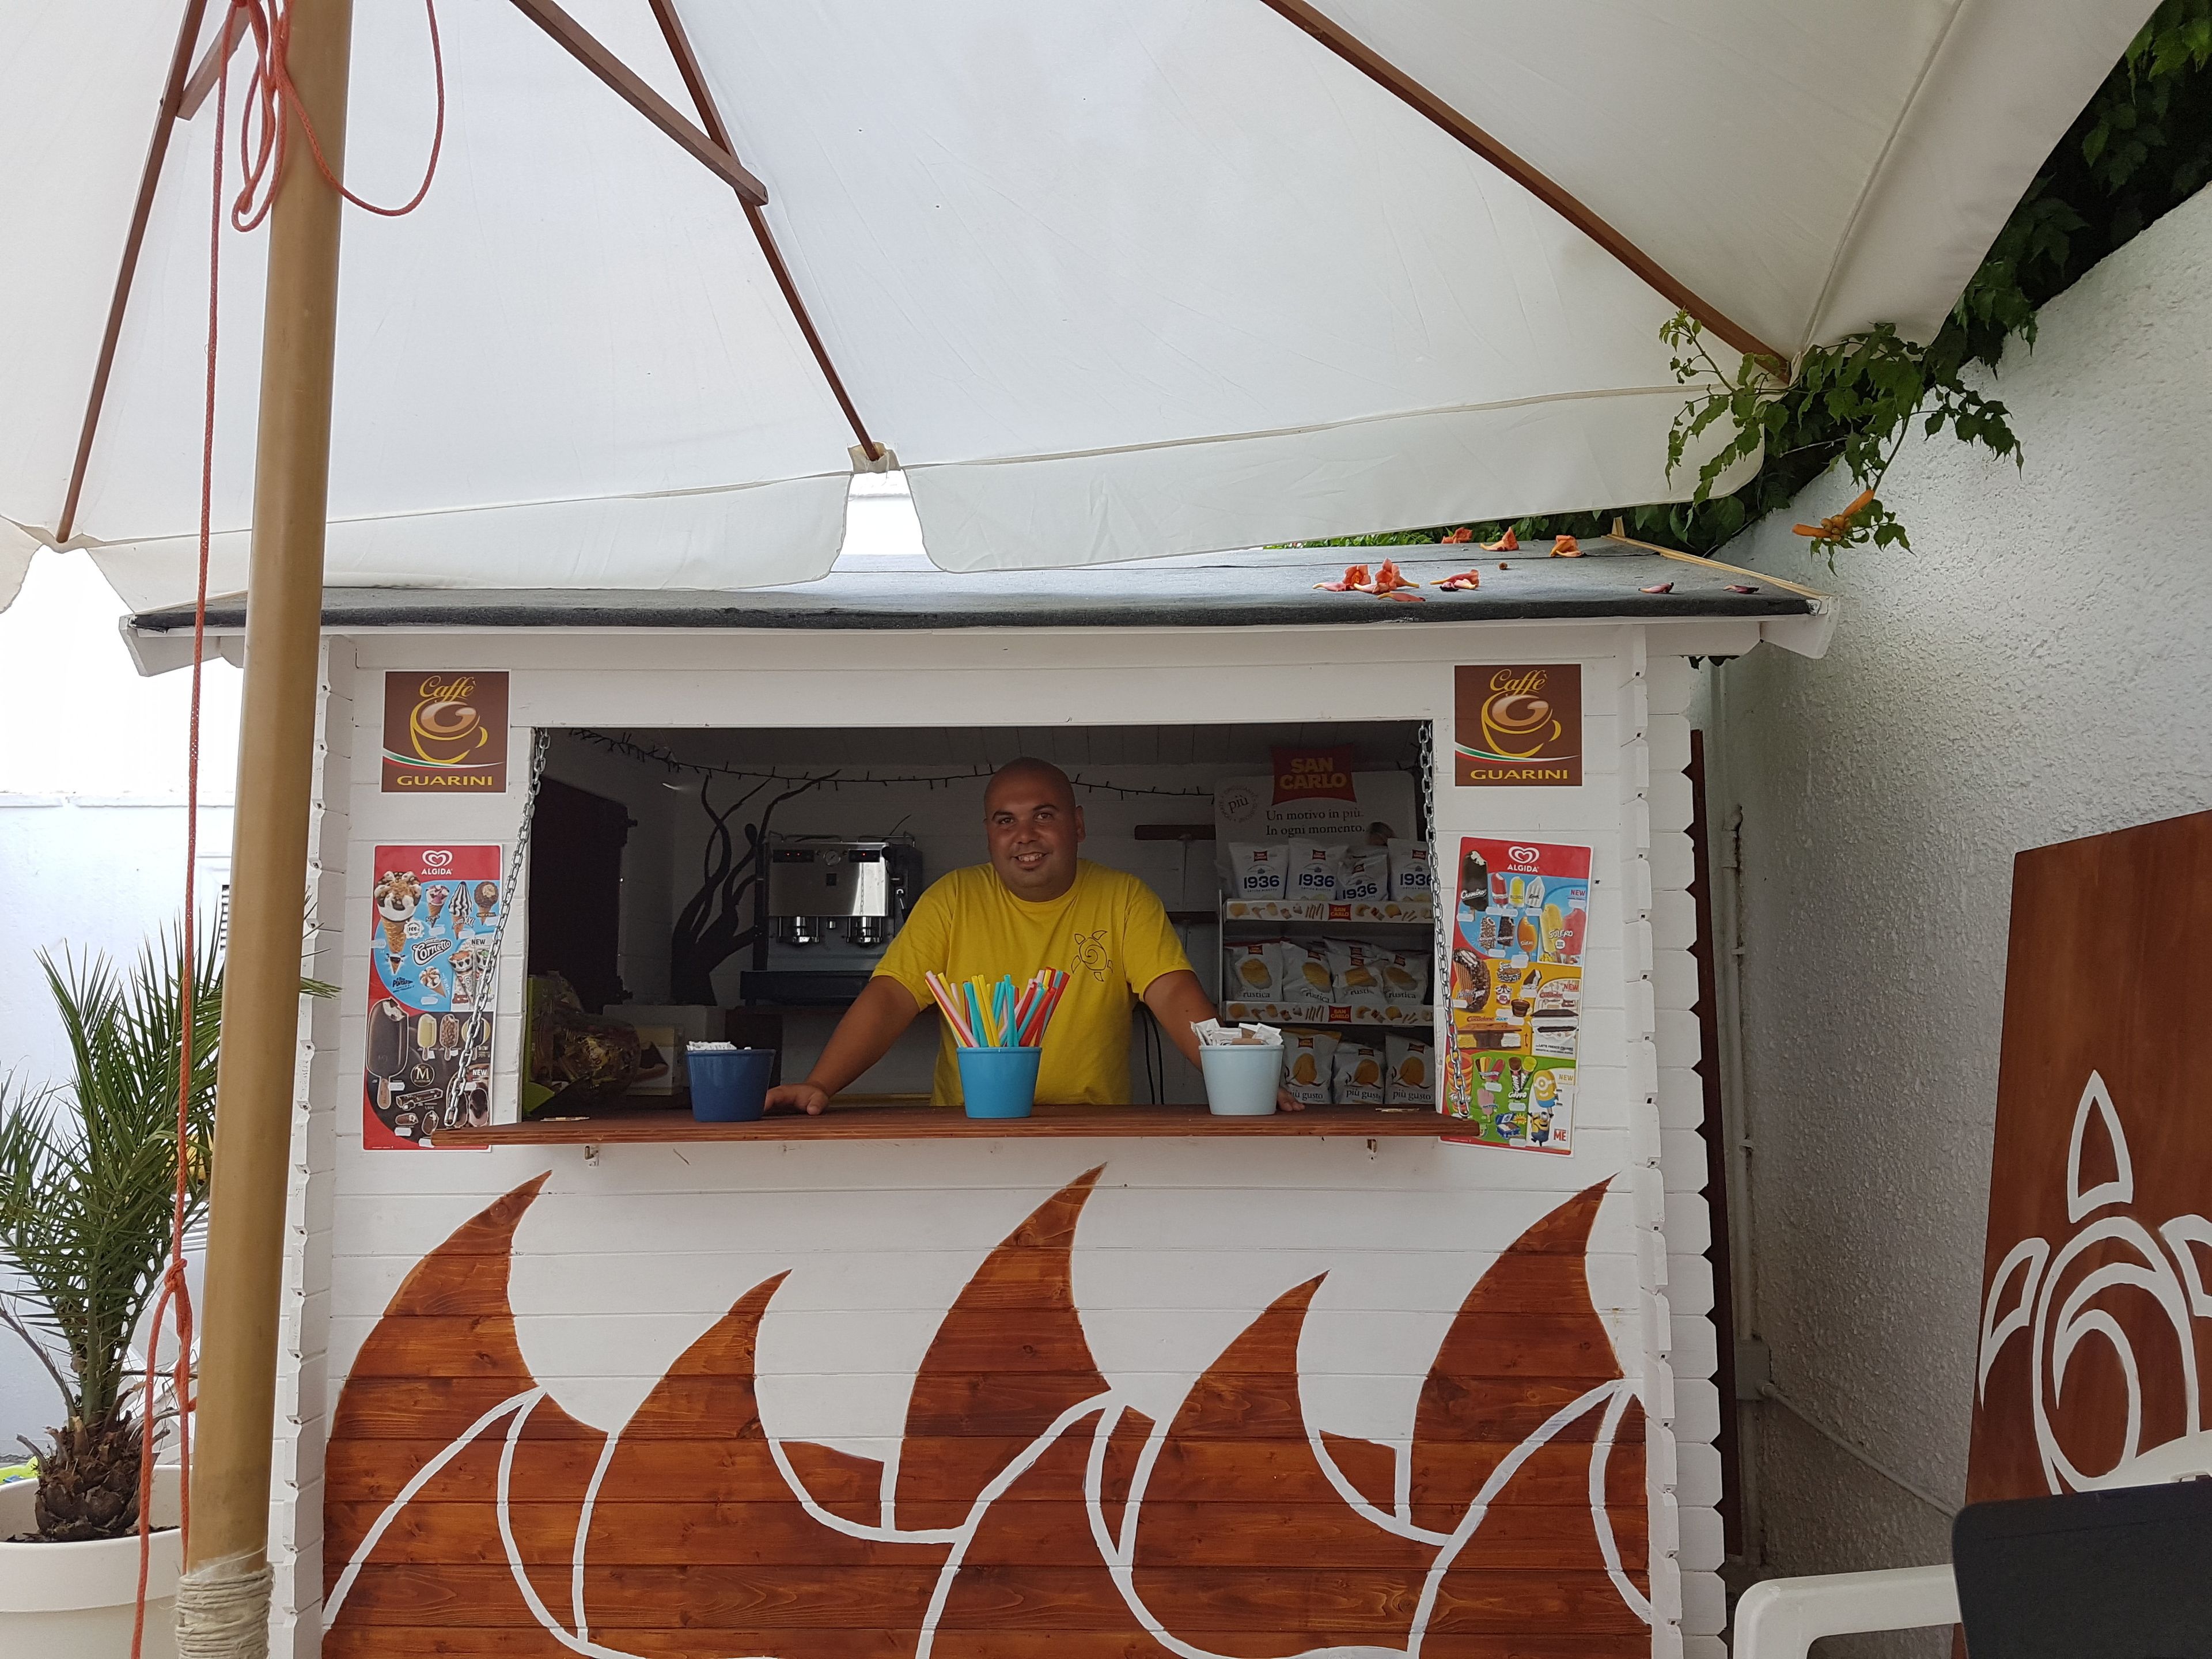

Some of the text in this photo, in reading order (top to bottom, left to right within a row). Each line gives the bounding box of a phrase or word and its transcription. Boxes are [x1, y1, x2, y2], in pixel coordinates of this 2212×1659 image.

[418, 675, 477, 703] Caffè
[1490, 669, 1548, 696] Caffè
[1291, 756, 1334, 773] SAN
[396, 775, 494, 786] GUARINI
[1279, 772, 1347, 790] CARLO
[1470, 769, 1568, 780] GUARINI
[1228, 795, 1249, 813] più
[1266, 810, 1283, 821] Un
[1286, 809, 1326, 820] motivo
[1328, 808, 1340, 819] in
[1266, 824, 1365, 838] In ogni momento.
[1507, 864, 1538, 873] ALGIDA
[1244, 875, 1280, 889] 1936
[1299, 874, 1335, 888] 1936
[1343, 882, 1377, 899] 1936
[1461, 889, 1487, 900] Cremino
[1548, 930, 1574, 940] SOLERO
[412, 940, 451, 965] Cornetto
[1302, 1092, 1323, 1103] gusto
[1346, 1088, 1359, 1099] più
[1392, 1089, 1431, 1100] più gusto
[1554, 1131, 1567, 1142] ME
